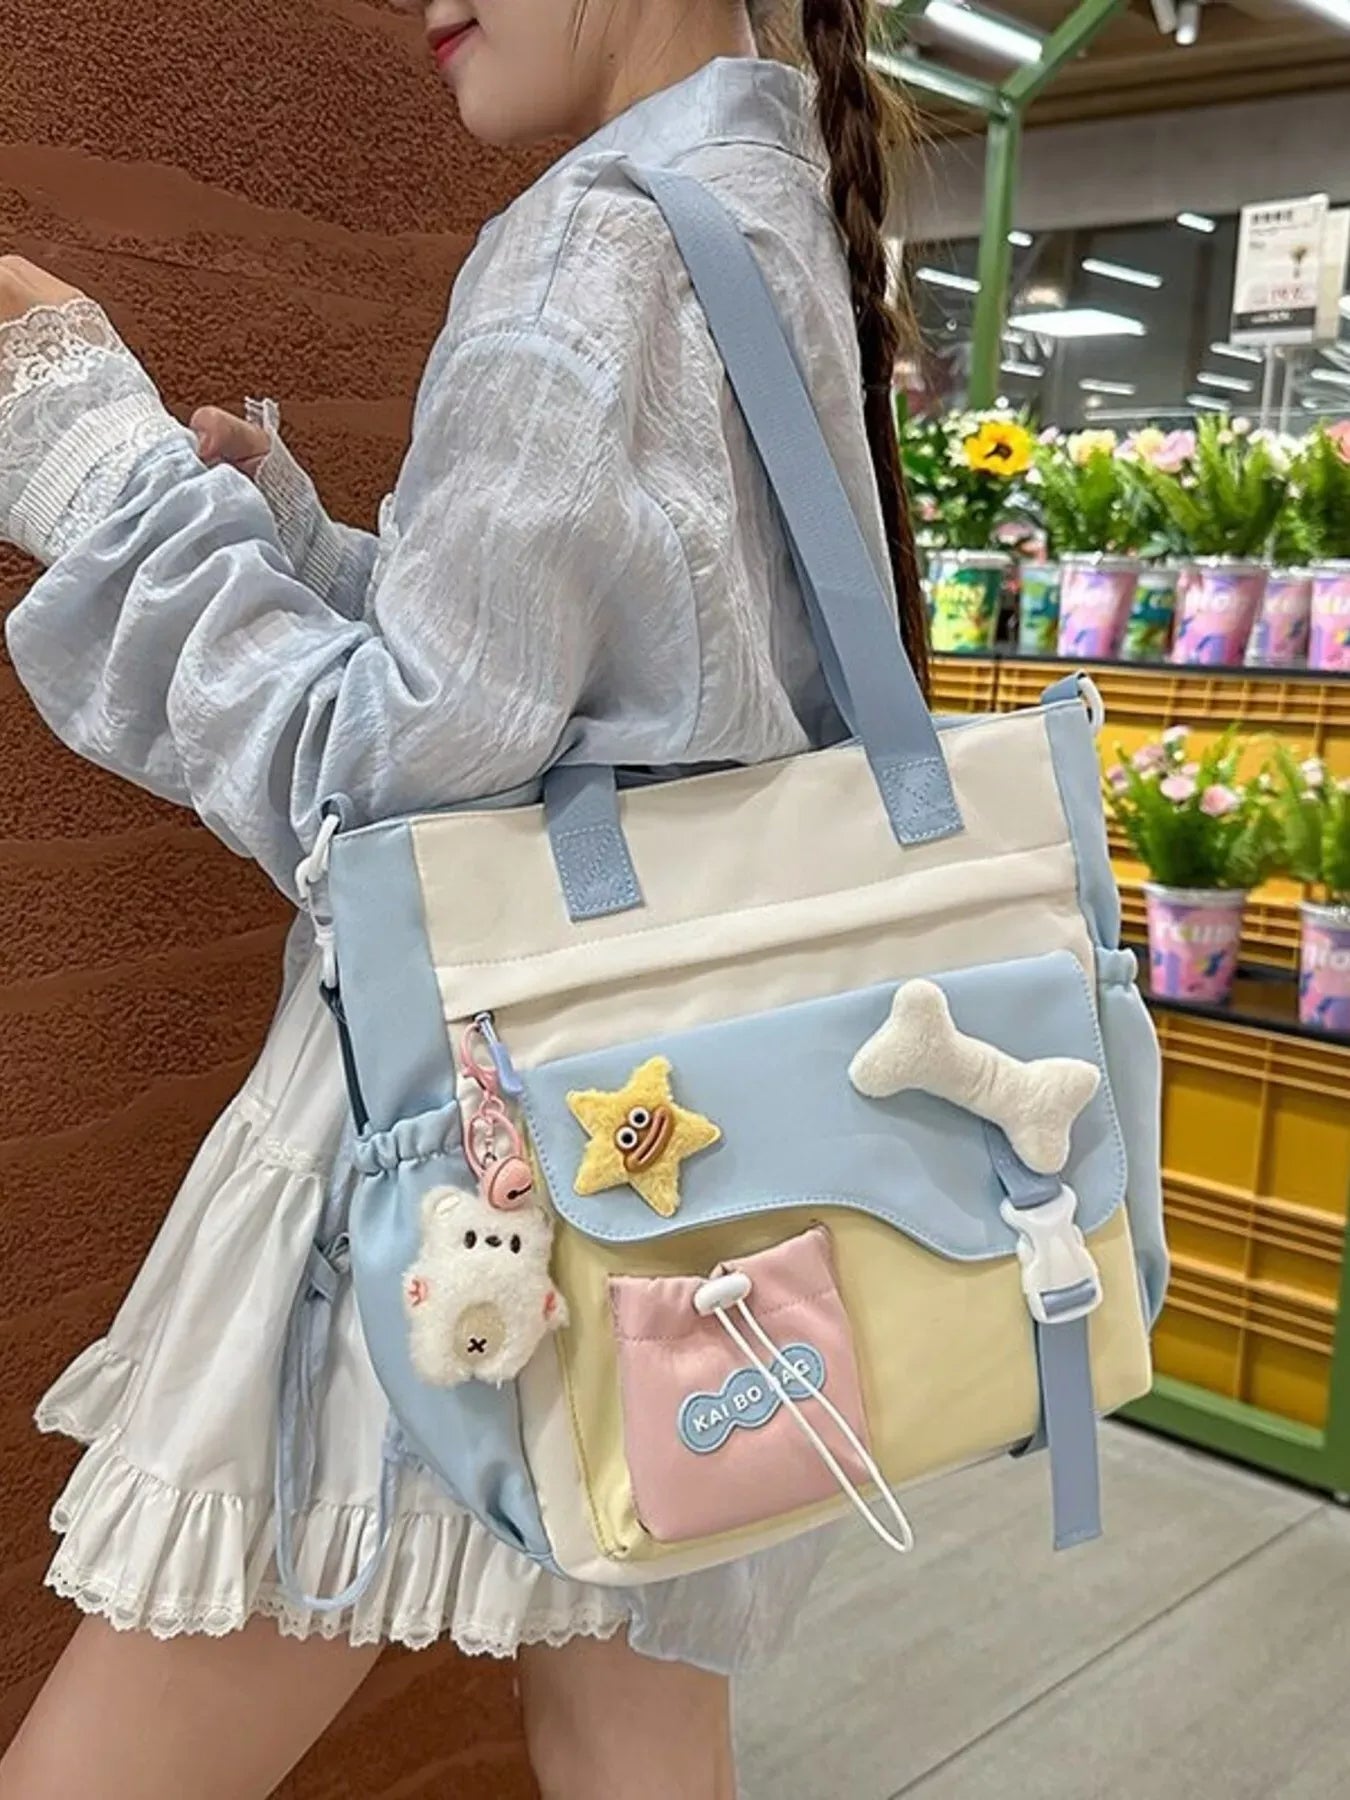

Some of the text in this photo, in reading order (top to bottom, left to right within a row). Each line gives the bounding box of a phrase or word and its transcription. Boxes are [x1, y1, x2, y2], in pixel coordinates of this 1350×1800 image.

[693, 1359, 811, 1432] KAI BO AG
